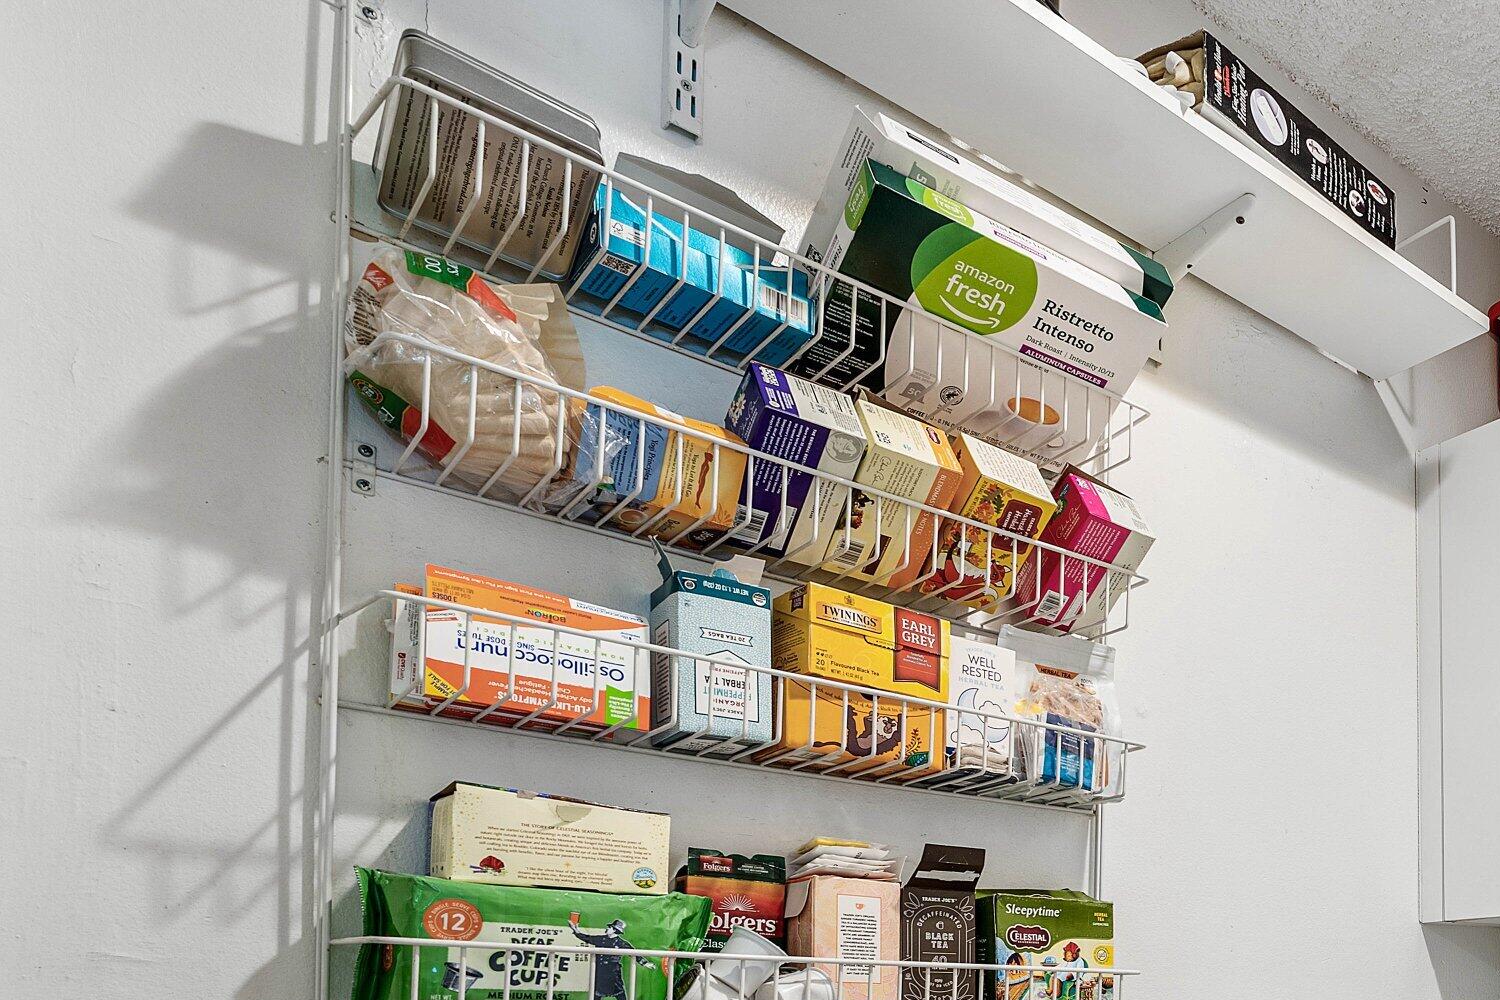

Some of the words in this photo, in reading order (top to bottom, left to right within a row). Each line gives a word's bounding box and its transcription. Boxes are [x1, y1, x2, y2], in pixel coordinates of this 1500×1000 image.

[954, 260, 1015, 295] amazon
[945, 274, 1006, 316] fresh
[1042, 299, 1114, 342] Ristretto
[1032, 317, 1095, 353] Intenso
[1026, 334, 1043, 347] Dark
[1044, 343, 1063, 356] Roast
[1068, 352, 1098, 372] Intensity
[1098, 367, 1115, 378] 10/13
[1025, 349, 1067, 374] ALUMINUM
[1066, 366, 1102, 386] CAPSULES
[907, 408, 925, 418] COFFEE
[644, 452, 656, 481] Principles
[916, 518, 927, 536] NOTES
[432, 592, 452, 602] DOSES
[528, 609, 566, 624] BOIRON
[822, 604, 878, 628] TWININGS
[708, 631, 724, 639] BAGS
[901, 618, 935, 637] EARL
[486, 636, 506, 644] DOSE
[725, 634, 737, 642] TEA
[901, 631, 935, 649] GREY
[830, 661, 856, 671] Flavoured
[967, 653, 996, 670] WELL
[962, 664, 1002, 682] RESTED
[1040, 667, 1060, 676] HERBAL
[488, 681, 509, 690] Fever
[519, 680, 546, 689] Fatigue
[958, 676, 989, 688] HERBAL
[703, 862, 730, 872] Folgers
[1006, 904, 1060, 917] Sleepytime
[440, 912, 466, 931] 12
[711, 912, 776, 933] olgers
[917, 911, 962, 929] DECAFFEINATED
[500, 926, 533, 934] TRADER
[536, 928, 559, 936] JOE'S
[925, 932, 954, 941] BLACK
[1010, 930, 1047, 942] CELESTIAL
[931, 941, 948, 949] TEA
[489, 951, 570, 972] COFFE
